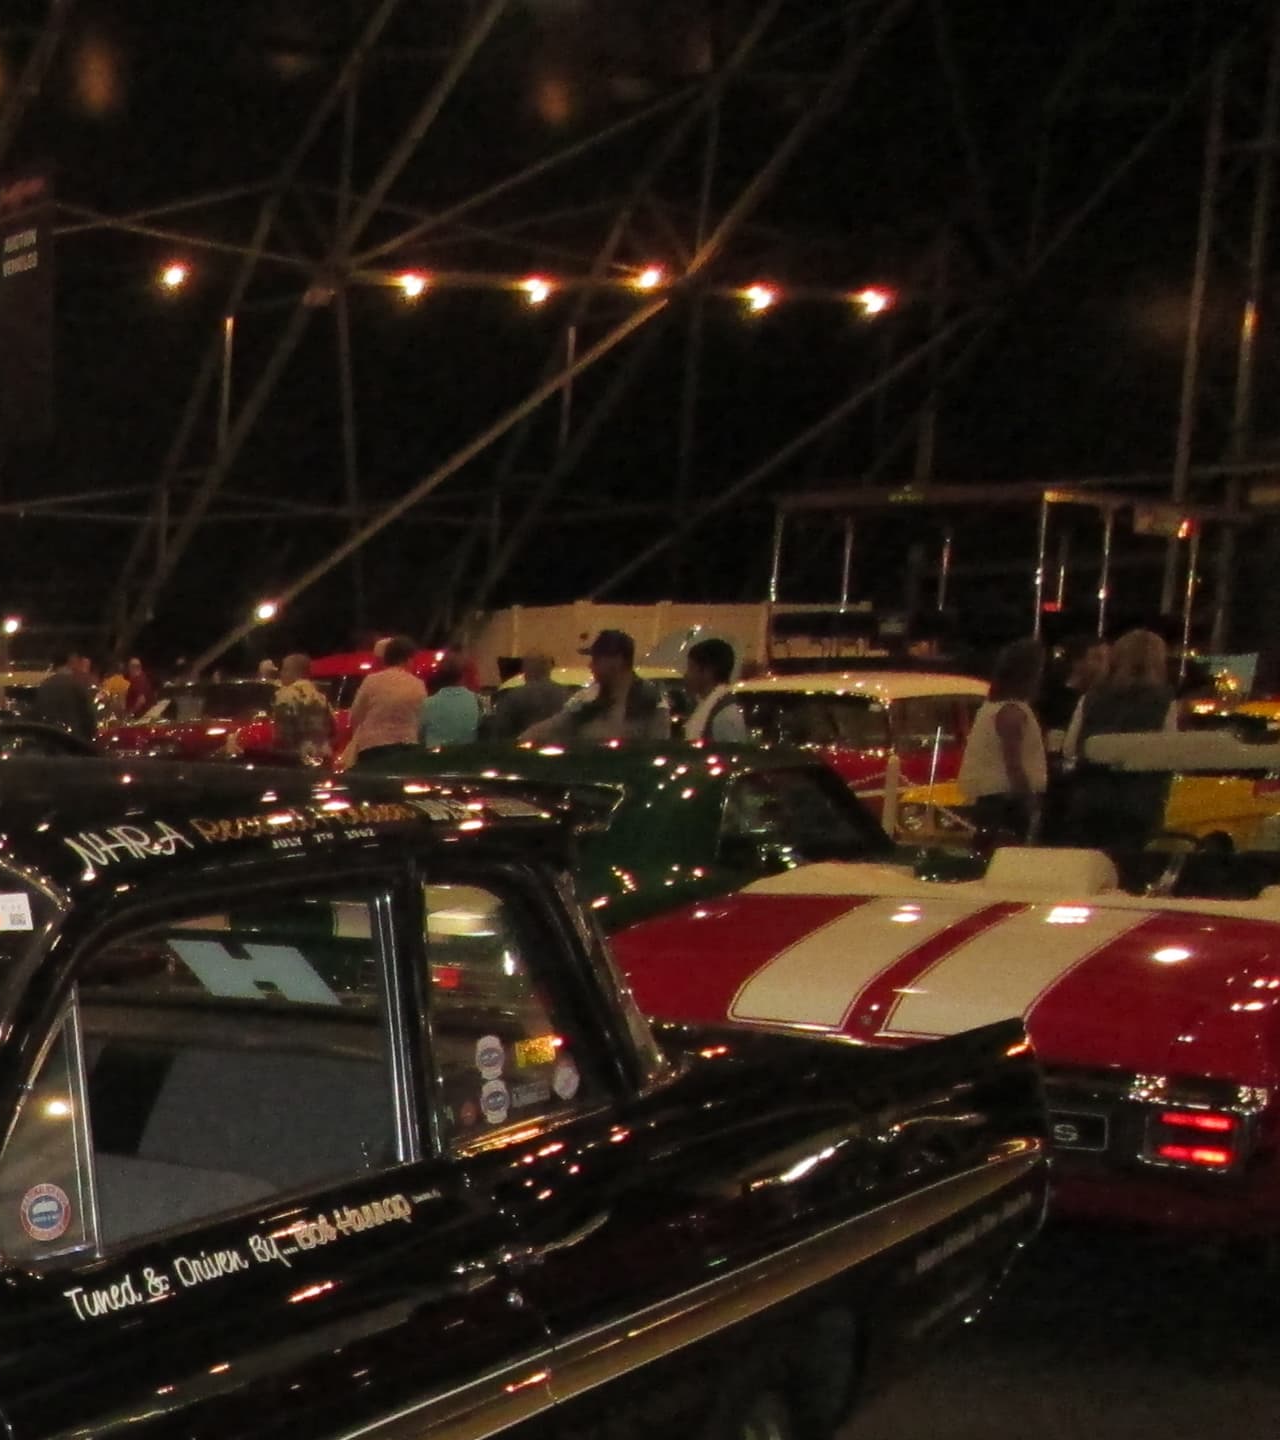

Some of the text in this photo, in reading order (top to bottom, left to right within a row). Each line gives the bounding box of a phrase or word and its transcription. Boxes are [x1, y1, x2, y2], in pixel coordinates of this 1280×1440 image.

[62, 820, 194, 874] NHRA
[271, 835, 303, 849] JULY
[64, 1277, 143, 1321] Tuned
[173, 1248, 249, 1288] Driven
